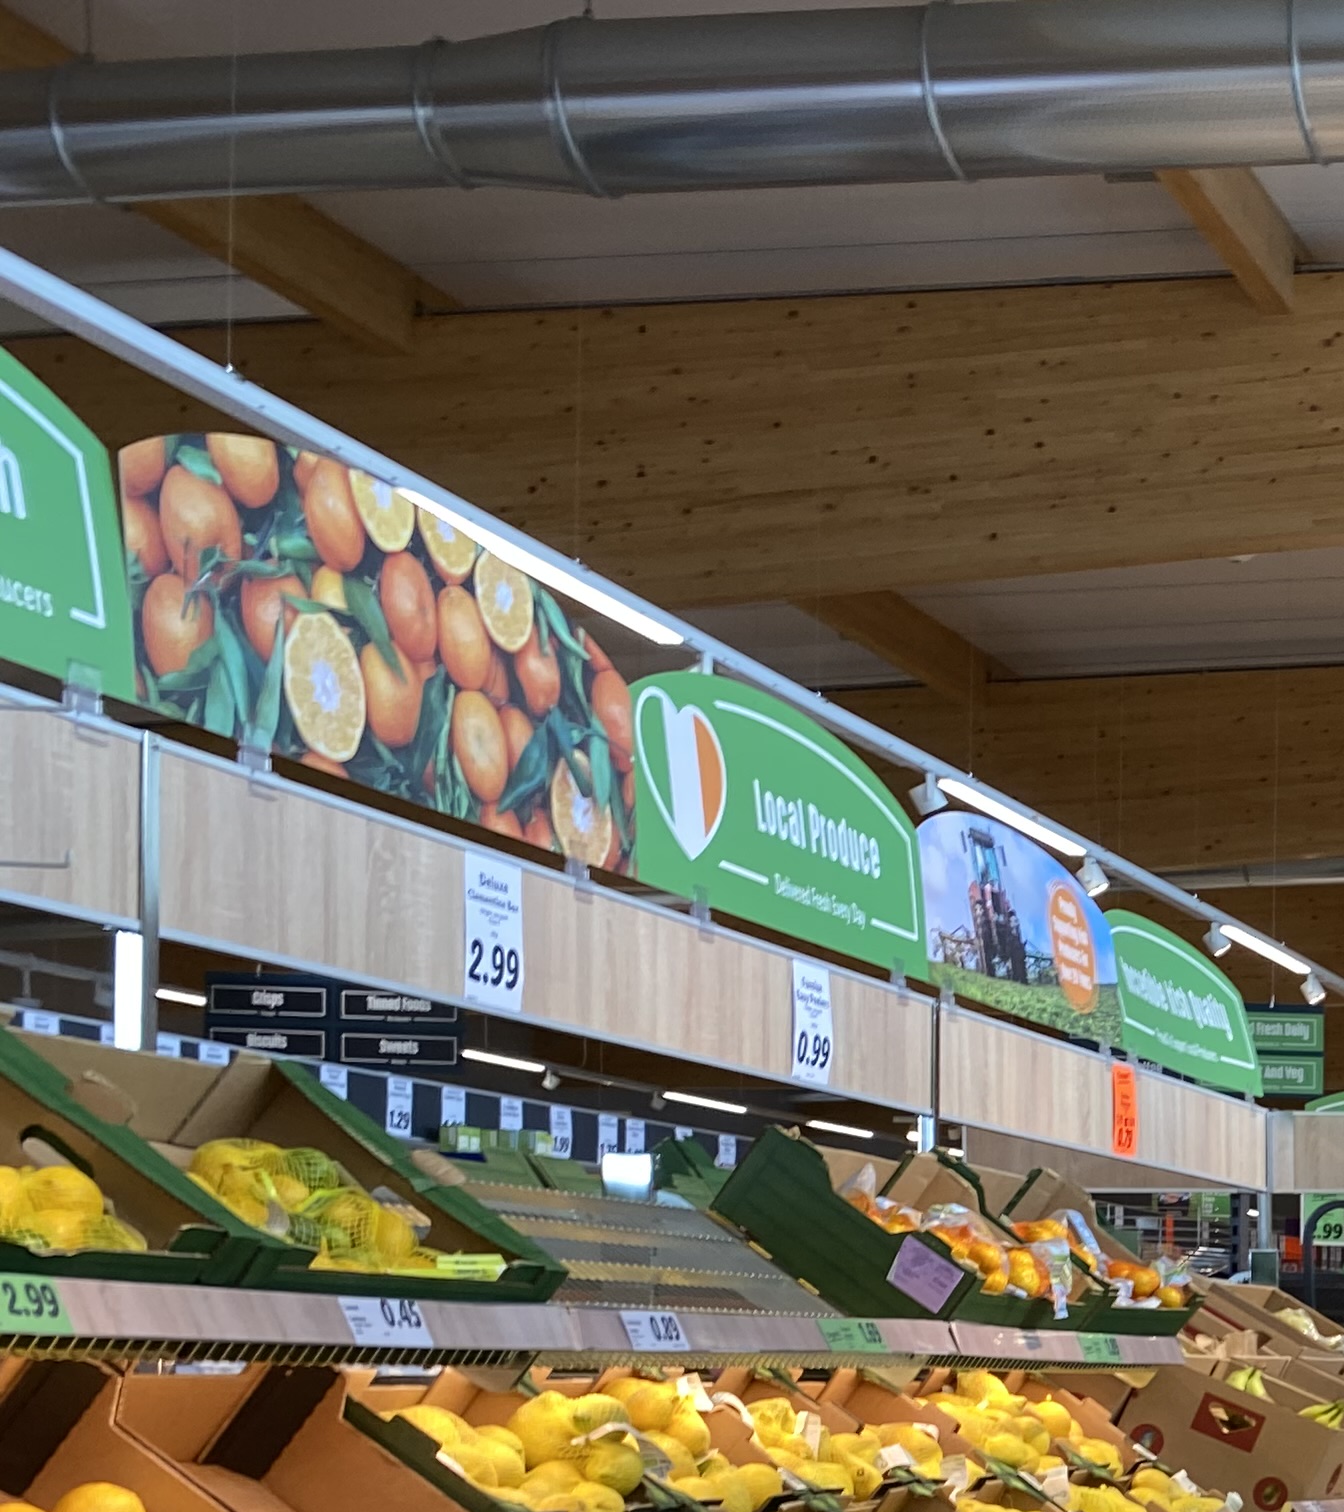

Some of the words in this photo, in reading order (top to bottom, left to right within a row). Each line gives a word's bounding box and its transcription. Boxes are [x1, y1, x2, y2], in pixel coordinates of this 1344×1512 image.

[753, 778, 806, 850] Local
[808, 802, 881, 880] Produce
[469, 937, 519, 990] 2.99
[1256, 1022, 1281, 1038] Fresh
[1285, 1022, 1310, 1040] Daily
[797, 1031, 830, 1069] 0.99
[1264, 1066, 1282, 1079] And
[2, 1281, 60, 1318] 2.99
